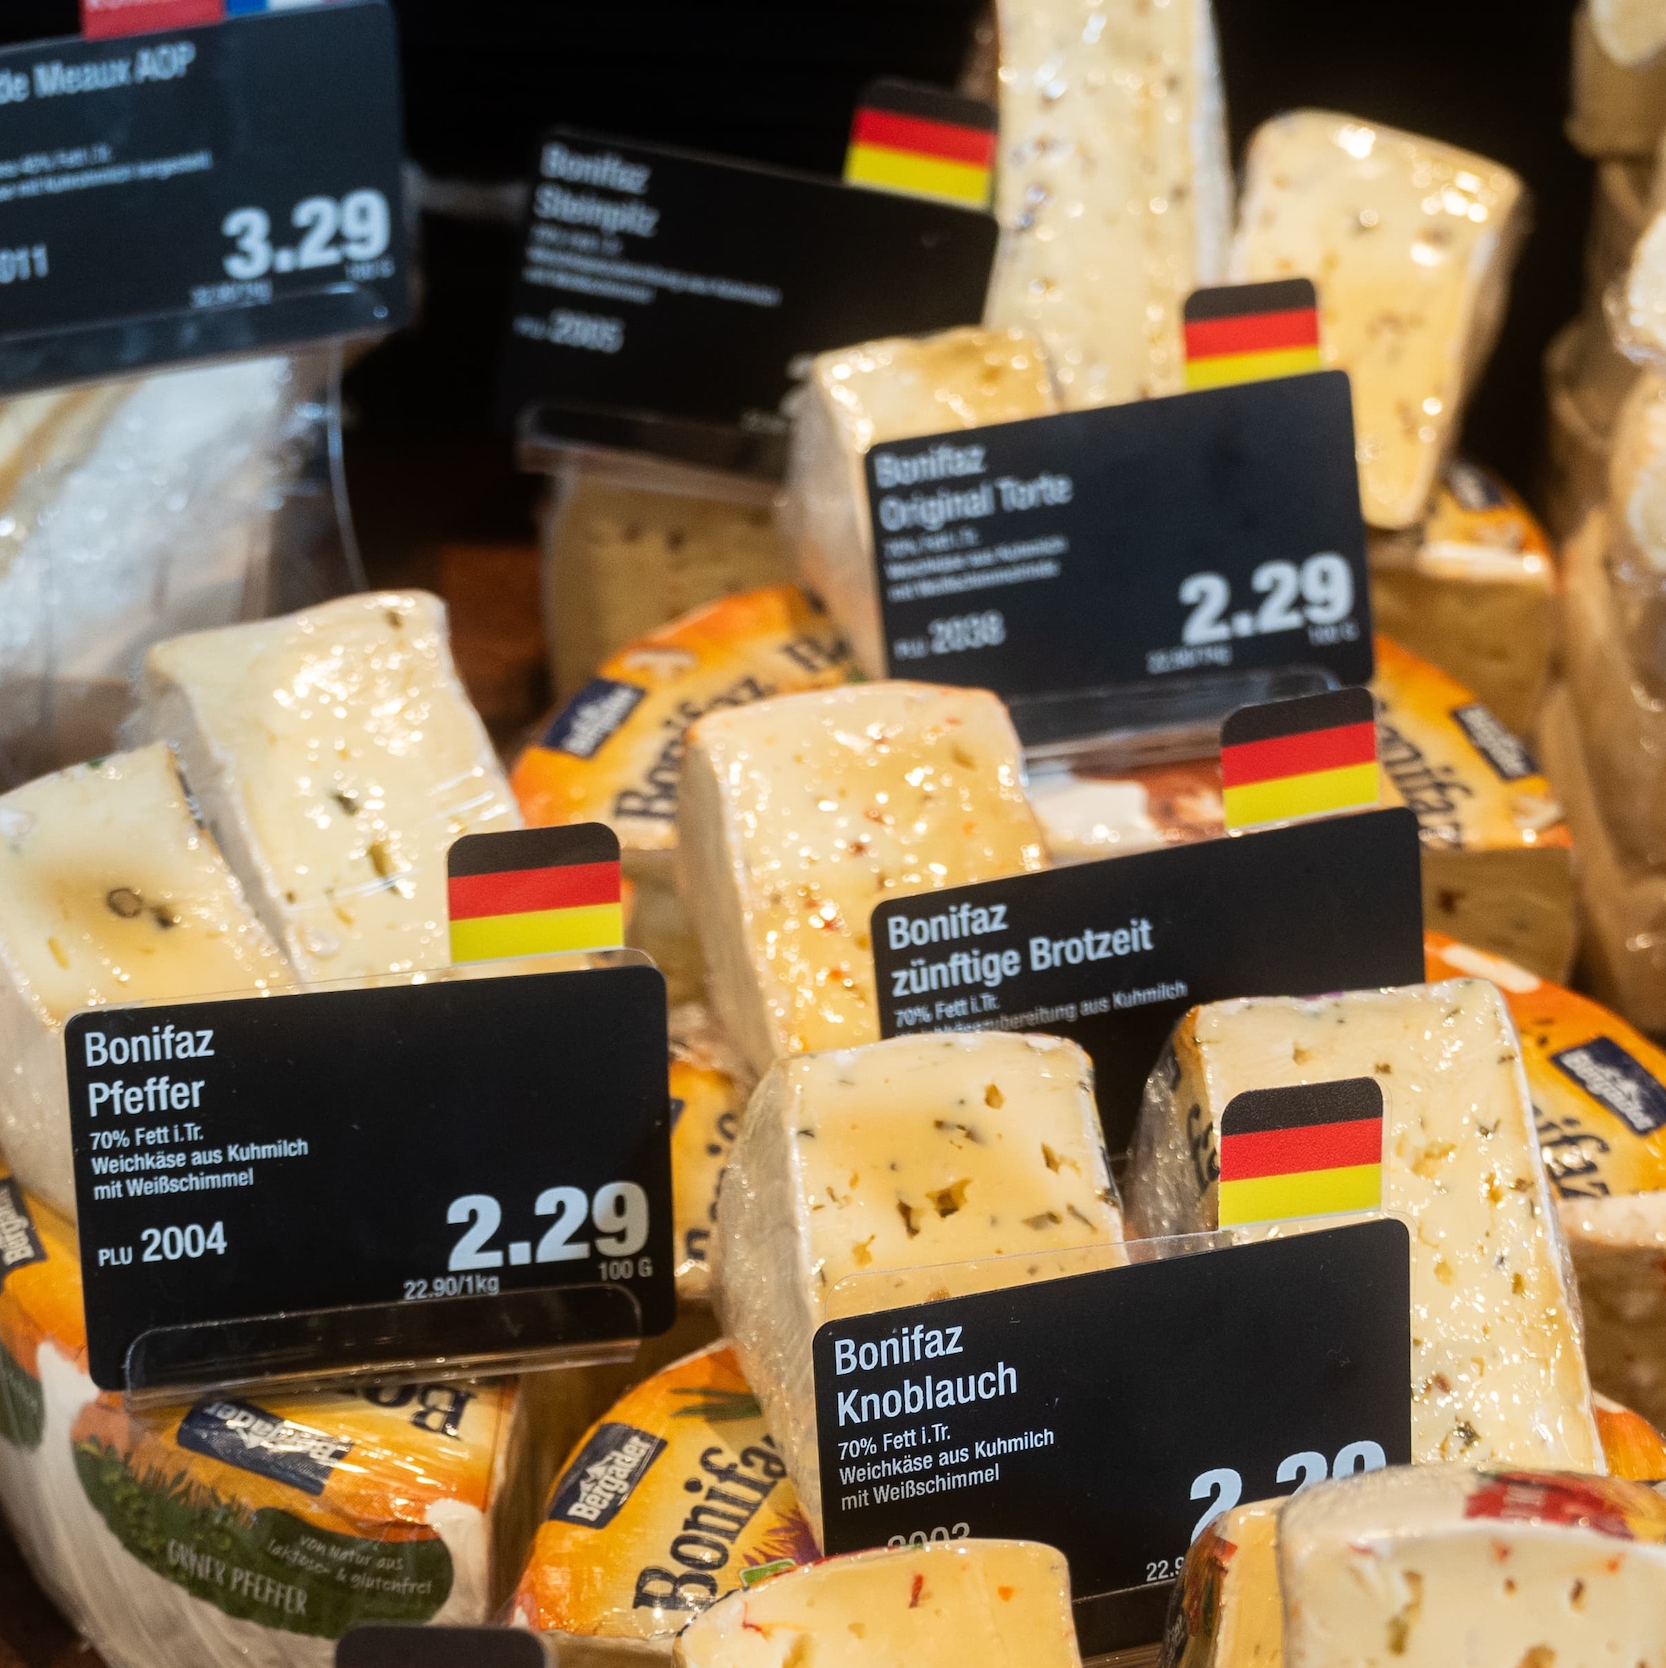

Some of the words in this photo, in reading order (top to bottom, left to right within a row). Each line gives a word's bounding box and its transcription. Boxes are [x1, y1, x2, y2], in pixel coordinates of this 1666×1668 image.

[222, 188, 391, 281] 3.29
[879, 484, 995, 532] Original
[995, 475, 1072, 511] Torte
[1178, 551, 1354, 646] 2.29
[887, 903, 1008, 950] Bonifaz
[891, 948, 1021, 998] zünftige
[1029, 918, 1154, 971] Brotzeit
[894, 1006, 933, 1028] 70%
[934, 998, 969, 1020] Fett
[970, 993, 997, 1013] i.Tr.
[84, 1024, 215, 1067] Bonifaz
[88, 1075, 206, 1118] Pfeffer
[89, 1129, 131, 1151] 70%
[134, 1125, 170, 1147] Fett
[173, 1122, 204, 1143] i.Tr.
[90, 1150, 187, 1175] Weichkäse
[190, 1148, 224, 1166] aus
[227, 1138, 309, 1162] Kuhmilch
[93, 1180, 124, 1201] mit
[125, 1167, 254, 1197] Weißschimmel
[98, 1246, 133, 1267] PLU
[140, 1220, 228, 1263] 2004
[447, 1181, 650, 1271] 2.29
[403, 1275, 500, 1301] 22.90/1kg
[598, 1258, 634, 1281] 100
[637, 1257, 653, 1278] G
[834, 1323, 964, 1376] Bonifaz
[837, 1361, 1018, 1427] Knoblauch
[837, 1436, 878, 1461] 70%
[882, 1428, 917, 1452] Fett
[921, 1423, 951, 1445] i.Tr.
[839, 1454, 933, 1485] Weichkäse
[938, 1447, 970, 1467] aus
[974, 1428, 1055, 1459] Kuhmilch
[567, 1434, 653, 1522] Bergader
[841, 1489, 870, 1511] mit
[872, 1462, 1000, 1504] Weißschimmel
[632, 1434, 788, 1612] Bonifa
[232, 1566, 308, 1616] PFEFFER
